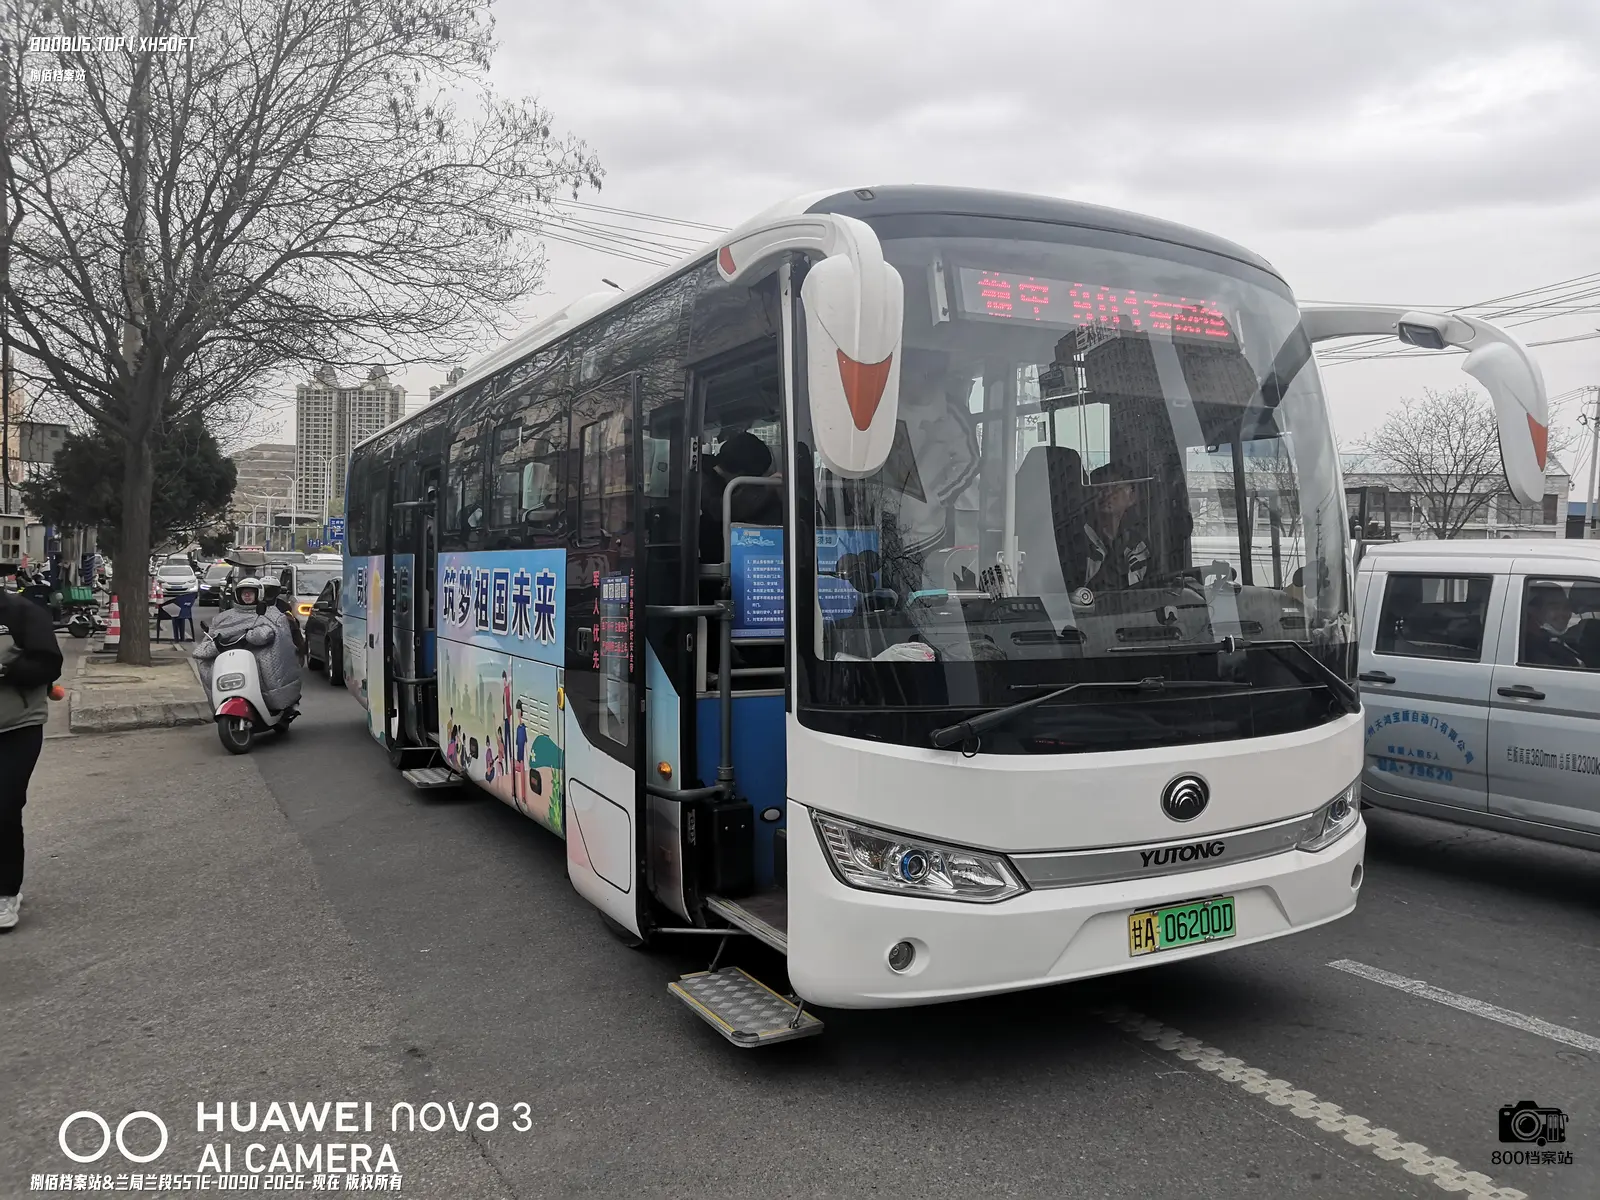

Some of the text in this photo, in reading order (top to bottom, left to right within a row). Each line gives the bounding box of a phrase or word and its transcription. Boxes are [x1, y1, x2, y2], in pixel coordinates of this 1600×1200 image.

[443, 566, 557, 646] 筑梦祖国未来
[592, 570, 600, 669] 军人优先
[1364, 710, 1474, 765] 州天鸿宝盾自动门有限公司
[1140, 841, 1225, 868] YUTONG
